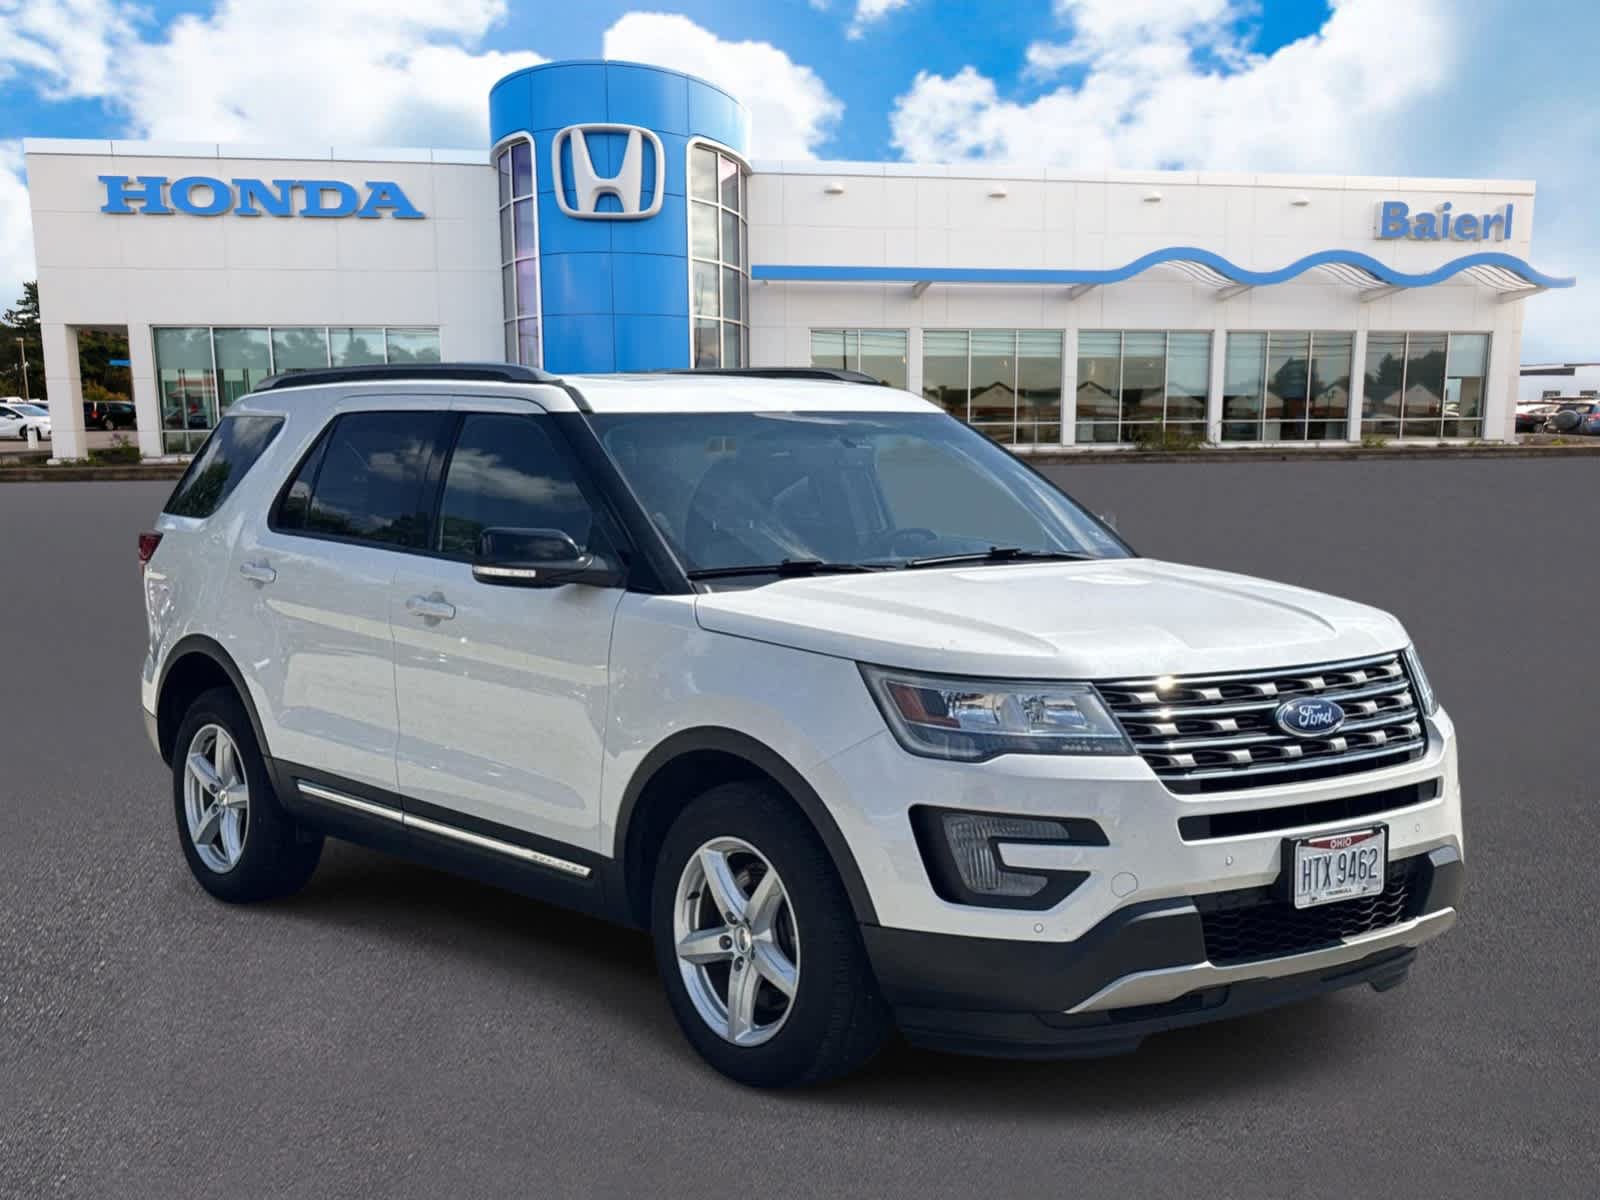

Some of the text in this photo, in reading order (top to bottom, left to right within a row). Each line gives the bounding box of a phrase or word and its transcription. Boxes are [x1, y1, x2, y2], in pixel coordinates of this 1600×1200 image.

[97, 175, 425, 219] HONDA
[1377, 201, 1514, 240] Baierl
[1298, 704, 1334, 728] Ford
[1329, 837, 1352, 849] OHIO
[1302, 847, 1378, 892] HTX 9462
